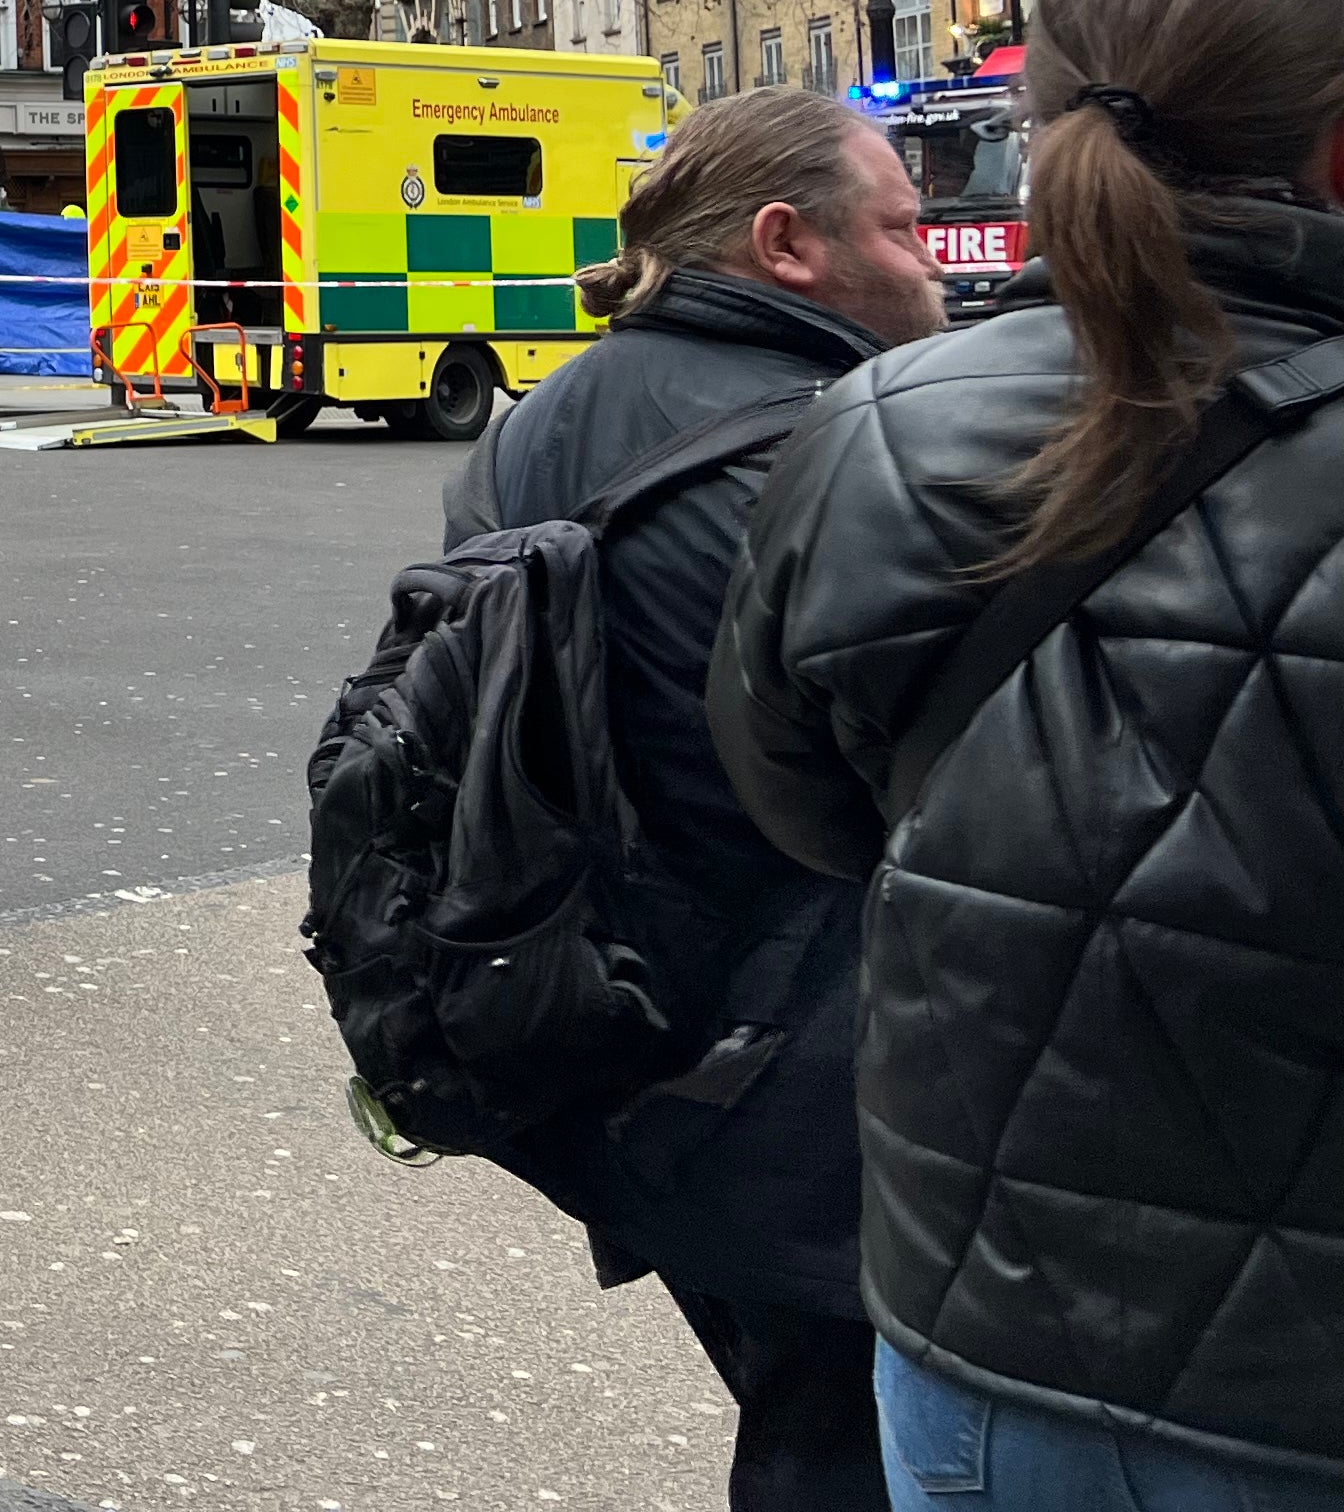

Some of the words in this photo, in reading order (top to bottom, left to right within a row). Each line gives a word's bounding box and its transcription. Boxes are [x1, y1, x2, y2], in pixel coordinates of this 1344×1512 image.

[172, 60, 269, 74] AMBULANCE
[276, 57, 296, 68] NHS
[28, 111, 60, 125] THE
[412, 99, 485, 126] Emergency
[489, 102, 560, 124] Ambulance
[437, 197, 460, 205] London
[462, 198, 496, 207] Ambulance
[497, 199, 518, 207] Service
[926, 227, 1007, 262] FIRE
[143, 294, 160, 306] AHL
